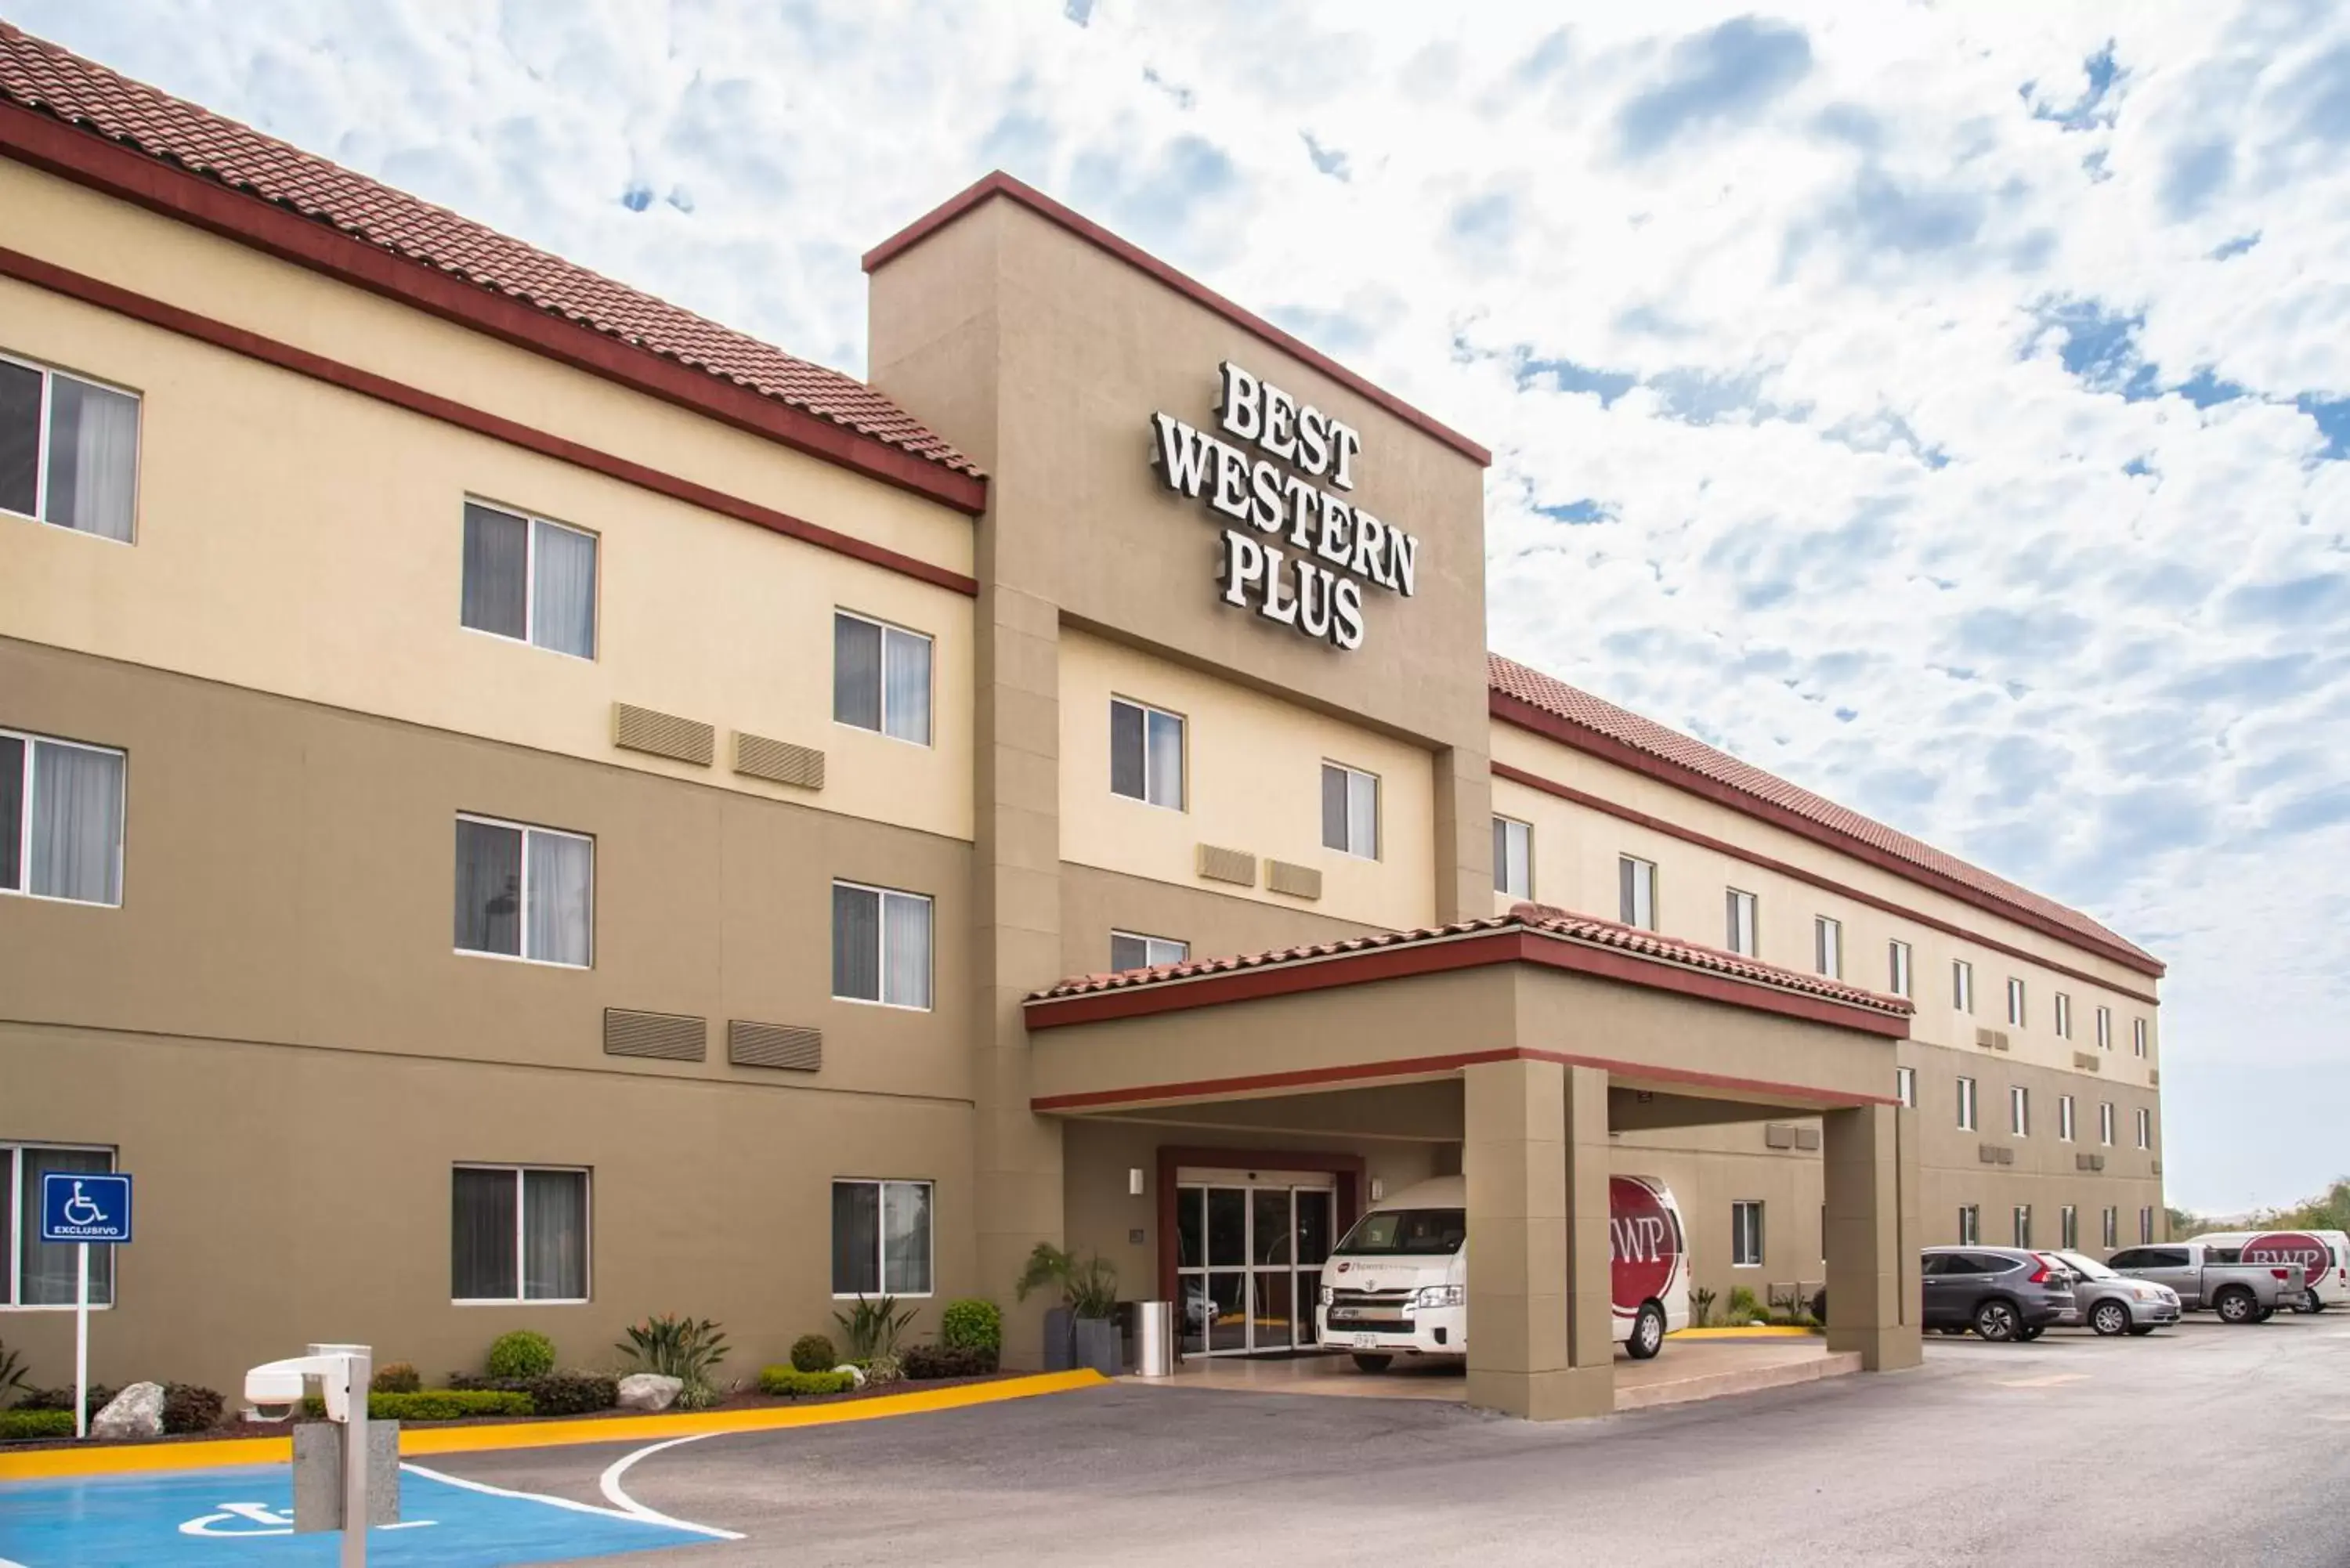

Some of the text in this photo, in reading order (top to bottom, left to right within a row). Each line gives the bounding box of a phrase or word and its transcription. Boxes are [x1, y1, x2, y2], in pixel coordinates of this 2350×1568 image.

[1220, 361, 1361, 490] BEST
[1152, 410, 1419, 597] WESTERN
[1220, 529, 1364, 650] PLUS
[54, 1226, 119, 1235] EXCLUSIVO
[1611, 1217, 1664, 1263] WP
